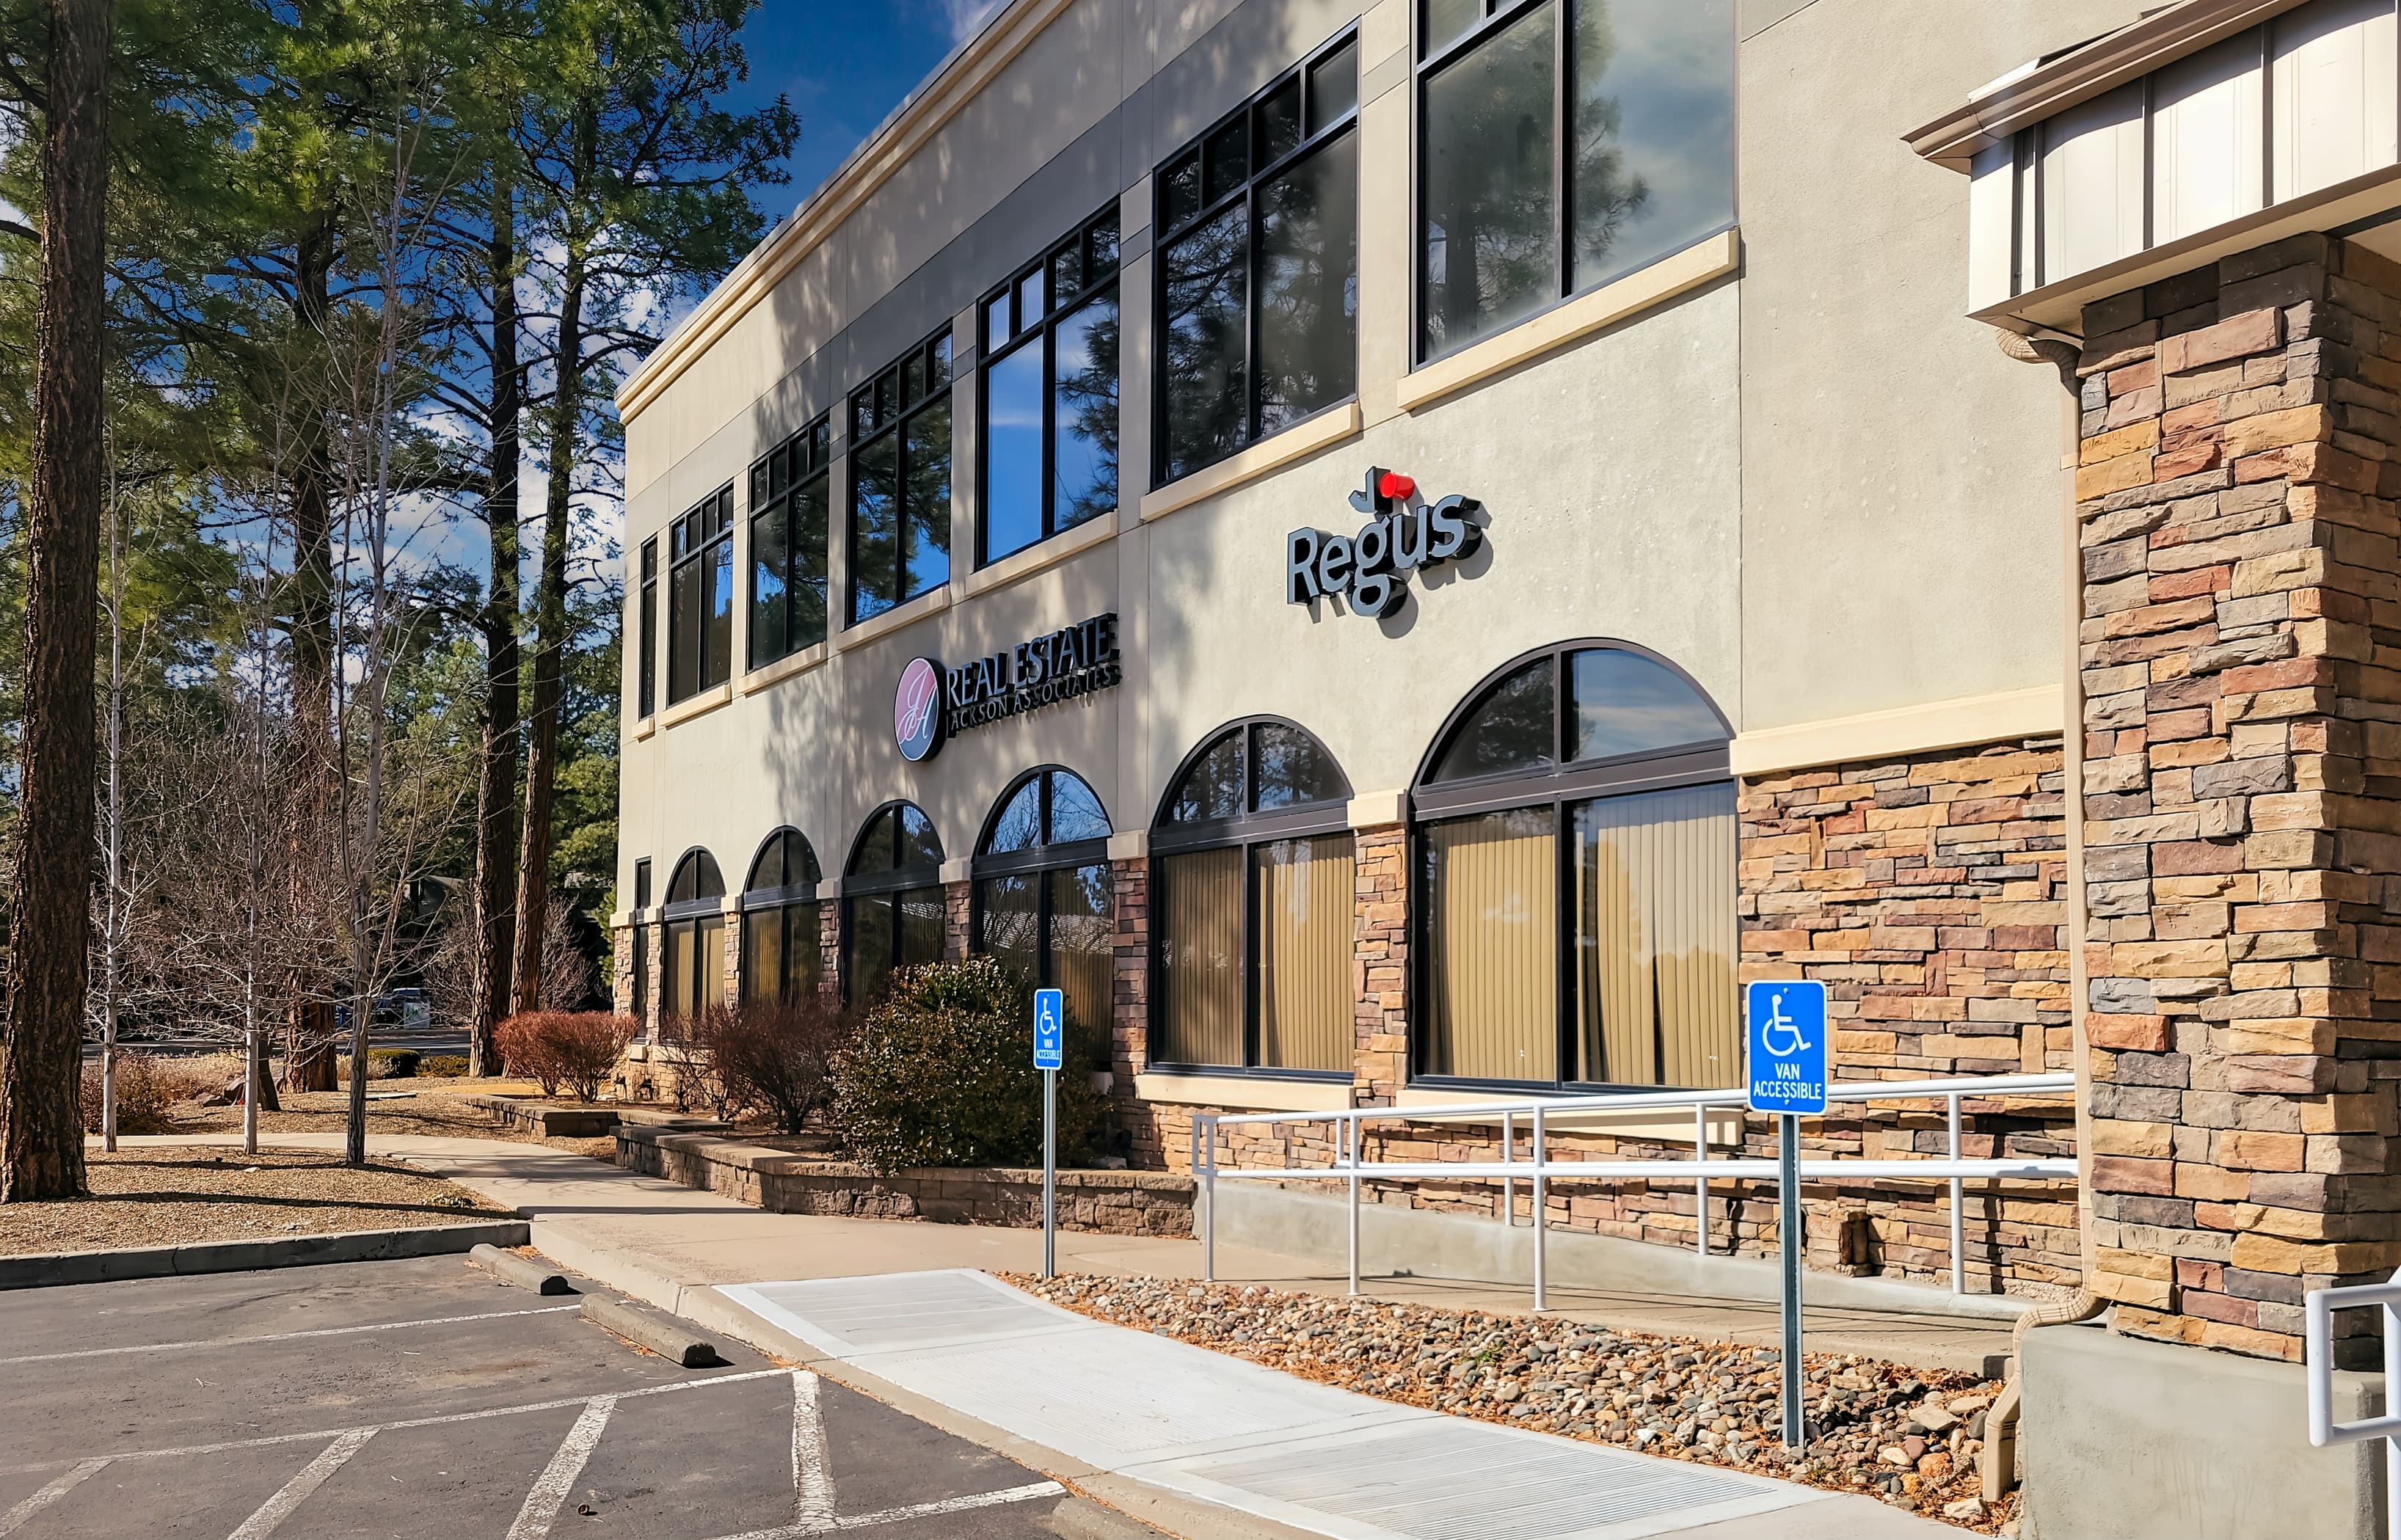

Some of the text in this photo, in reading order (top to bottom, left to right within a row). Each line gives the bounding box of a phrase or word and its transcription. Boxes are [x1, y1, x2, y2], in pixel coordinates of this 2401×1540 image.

[1287, 494, 1473, 618] Regus
[946, 613, 1119, 710] REAL ESTATE
[946, 664, 1118, 738] JACKSON ASSOCIATES
[1753, 1080, 1822, 1100] ACCESSIBLE
[1775, 1063, 1800, 1080] VAN
